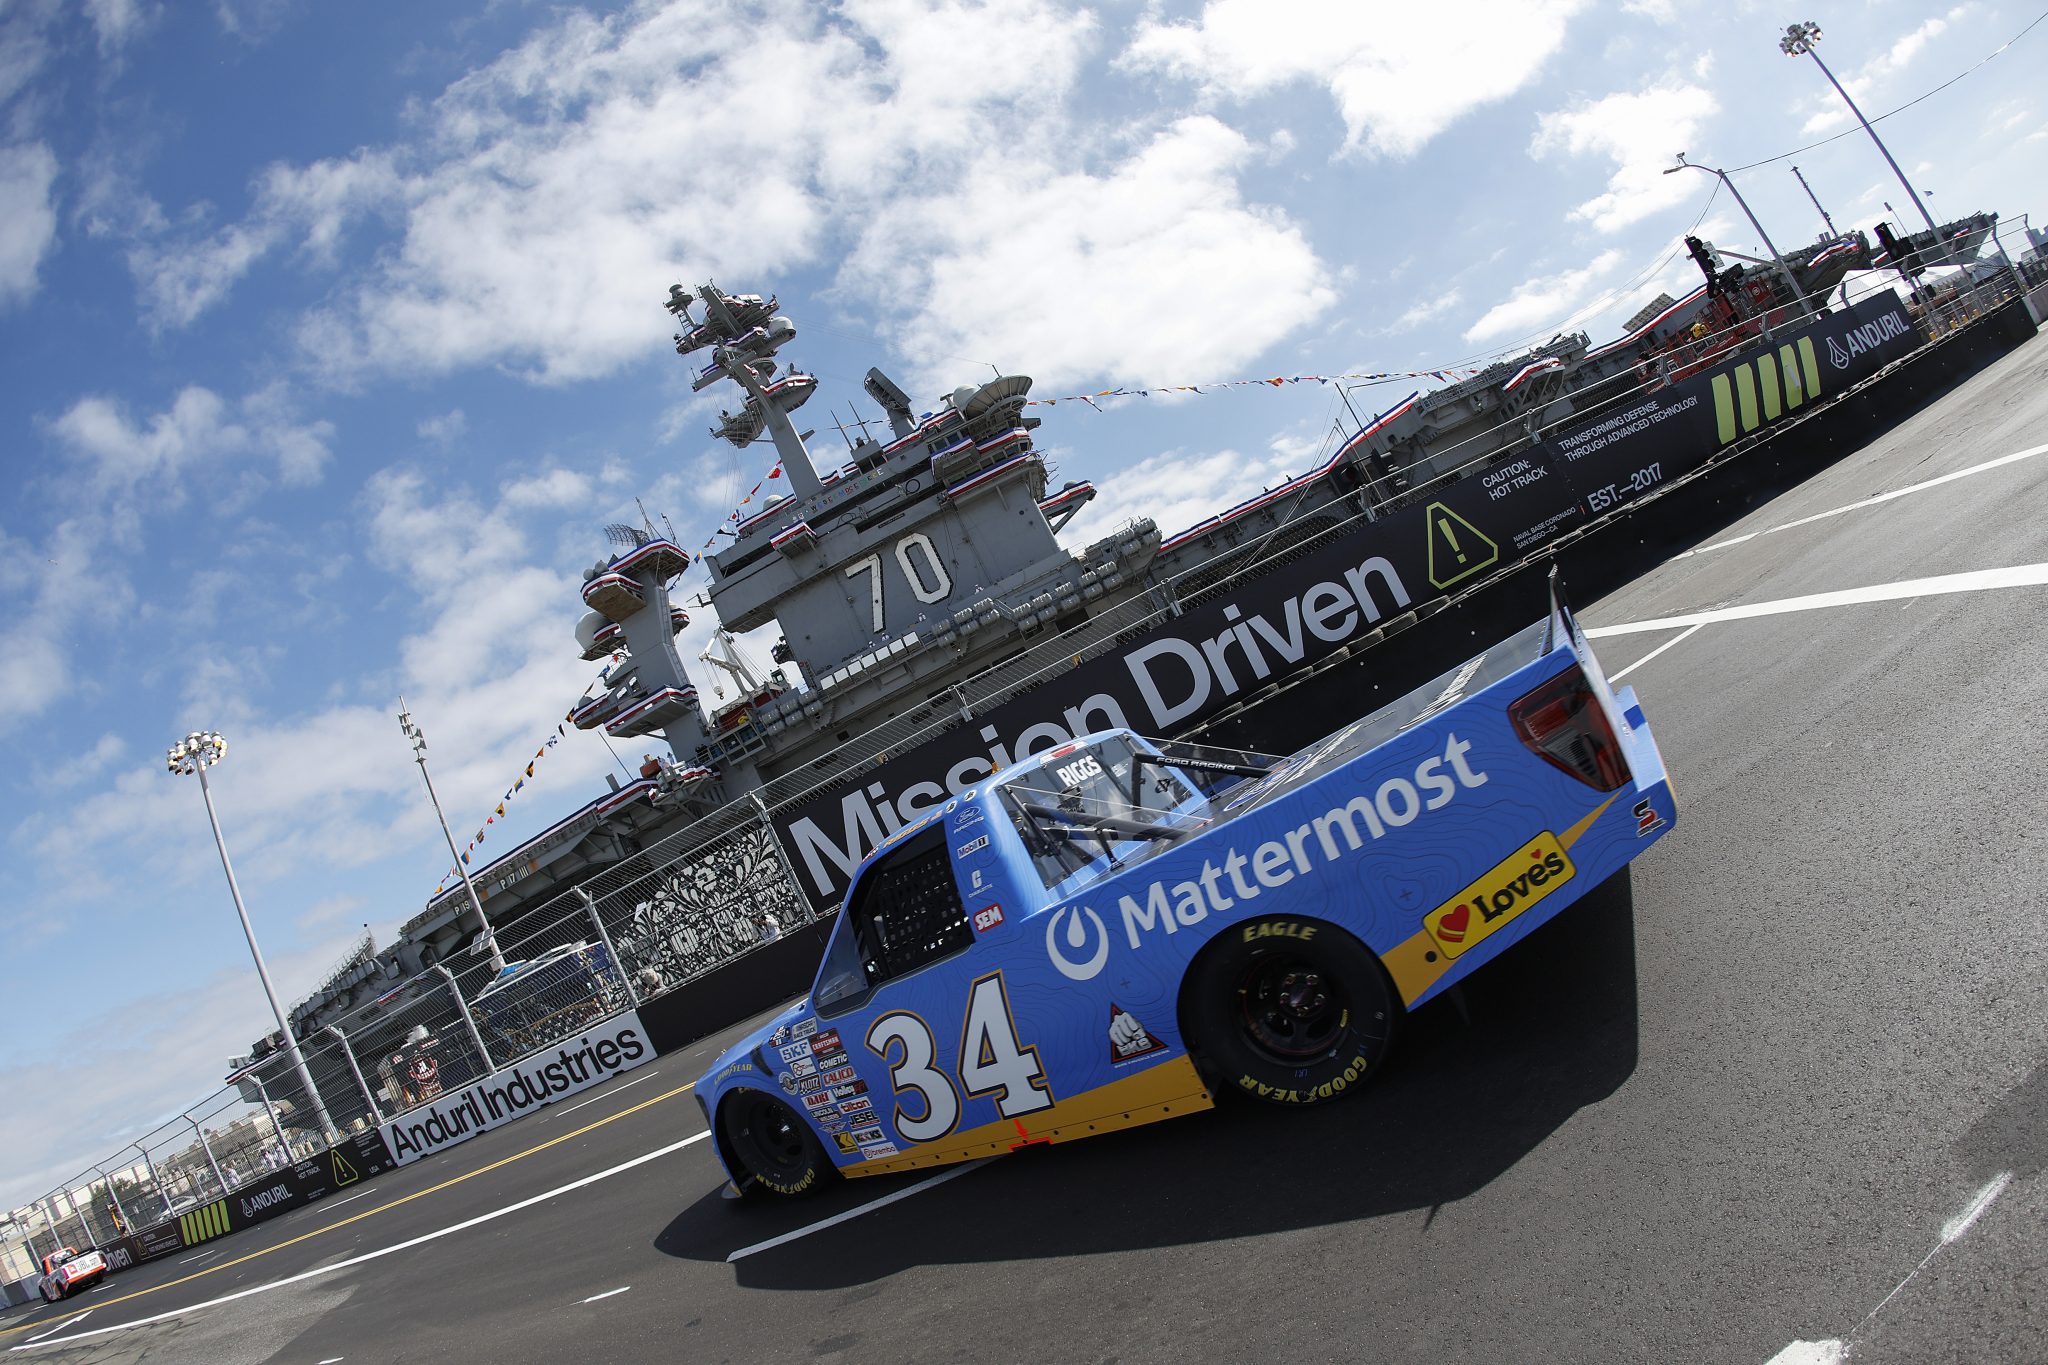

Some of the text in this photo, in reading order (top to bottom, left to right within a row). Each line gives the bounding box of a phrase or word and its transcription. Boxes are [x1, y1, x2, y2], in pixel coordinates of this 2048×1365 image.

[1846, 310, 1910, 358] ANDURIL
[1558, 400, 1660, 451] TRANSFORMING DEFENSE
[1565, 395, 1699, 462] THROUGH ADVANCED TECHNOLOGY
[1482, 459, 1532, 489] CAUTION:
[1489, 465, 1549, 501] HOT TRACK
[1512, 506, 1577, 543] NAVAL BASE CORONADO
[1516, 539, 1530, 550] SAN
[844, 532, 954, 633] 70
[1123, 556, 1412, 730] Driven
[1056, 754, 1103, 788] RIGGS
[1156, 756, 1236, 771] FORD RACING
[1118, 732, 1489, 950] Mattermost
[500, 879, 507, 890] P
[508, 872, 516, 884] 17
[454, 906, 460, 916] P
[974, 906, 1003, 931] SEM
[1242, 922, 1318, 943] EAGLE
[782, 1041, 808, 1060] SKF
[820, 1053, 848, 1070] COMETIC
[864, 969, 1056, 1145] 34
[714, 1063, 752, 1086] GOODYEAR
[800, 1078, 820, 1091] KLOTZ
[823, 1067, 854, 1084] CALICO
[1239, 1055, 1368, 1104] GOODYEAR
[390, 1029, 645, 1160] Anduril Industries
[833, 1085, 855, 1097] Holley
[849, 1110, 878, 1125] JESEL
[869, 1146, 896, 1157] brembo
[298, 1165, 320, 1180] HOT TRACK
[756, 1168, 815, 1195] GOODYEAR
[251, 1184, 293, 1212] ANDURIL
